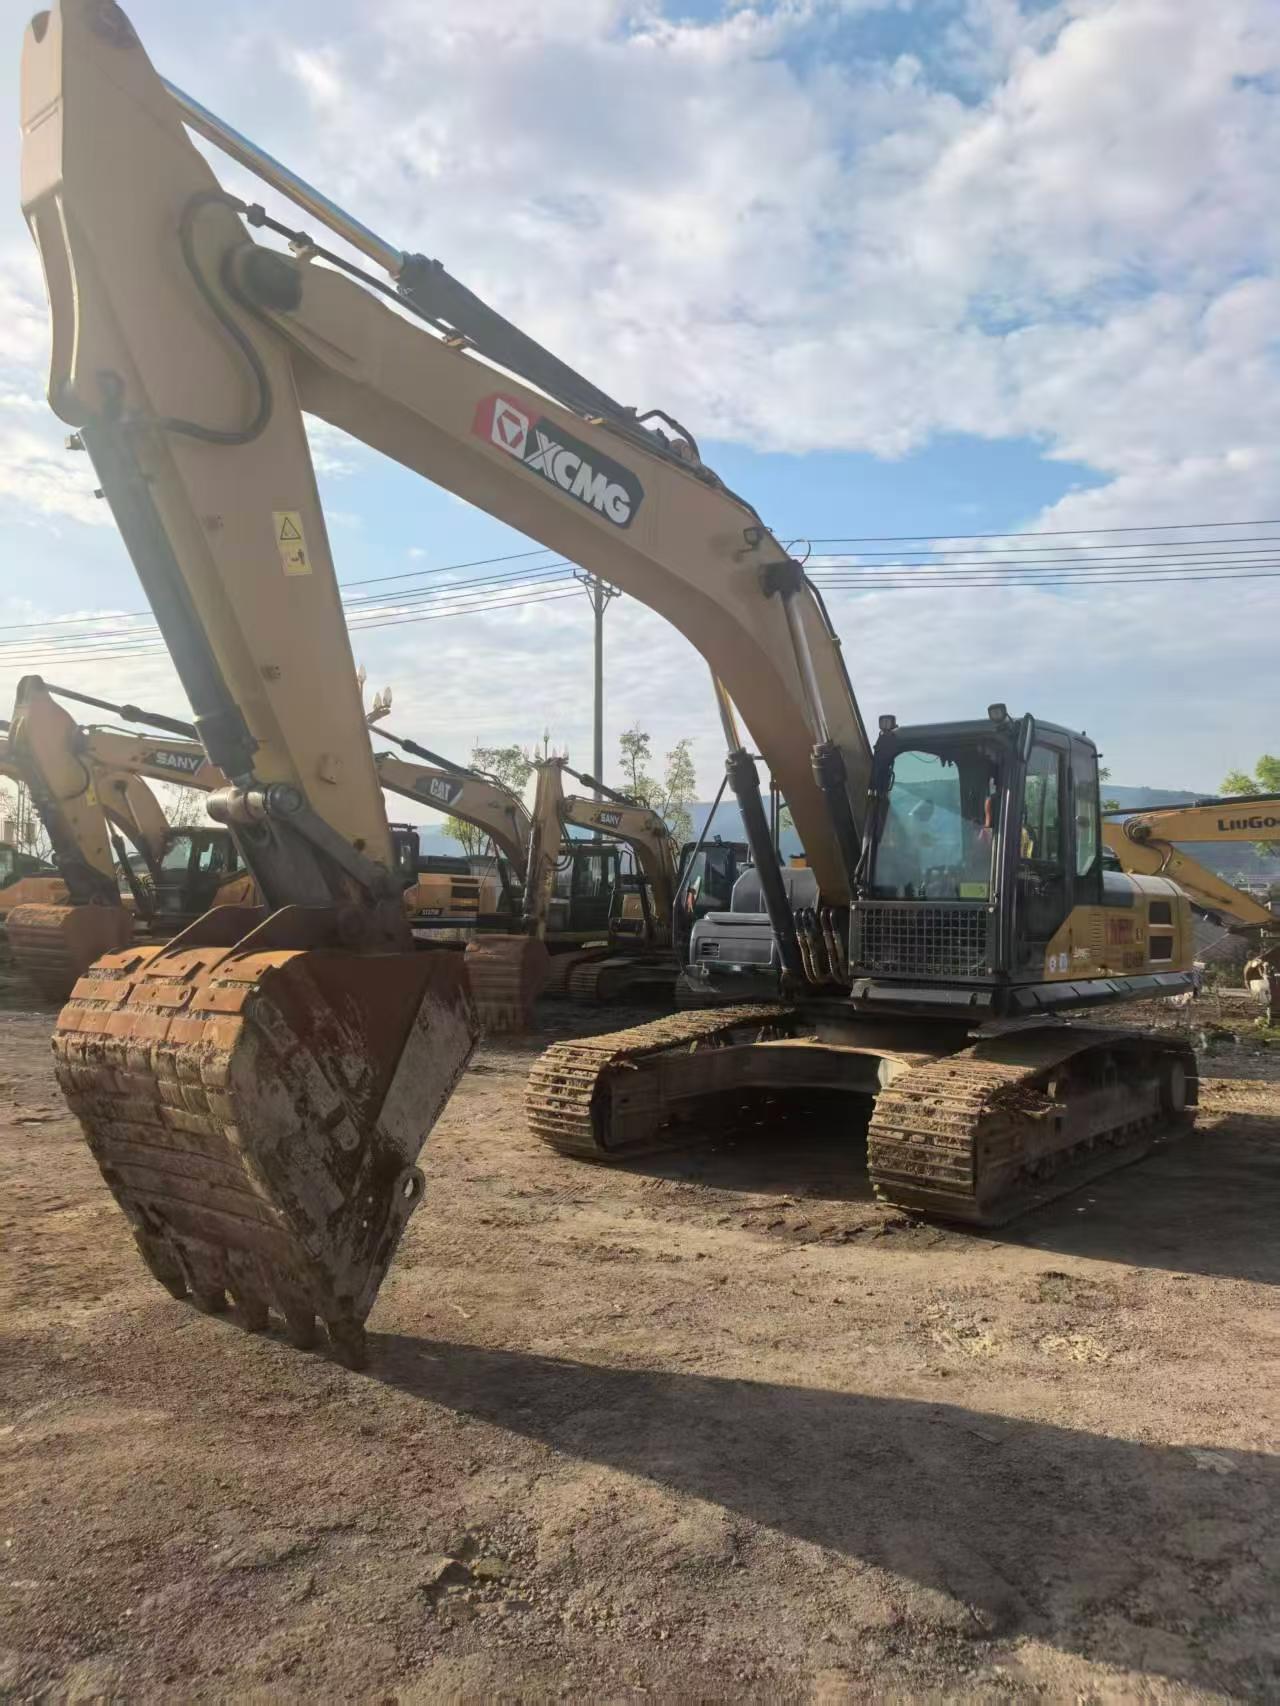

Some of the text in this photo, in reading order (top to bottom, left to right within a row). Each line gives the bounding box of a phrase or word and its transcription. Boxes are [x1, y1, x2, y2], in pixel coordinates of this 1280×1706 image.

[524, 429, 631, 525] XCMG
[156, 752, 199, 770] SANY
[430, 777, 451, 801] CAT
[1217, 815, 1280, 832] LiuGo
